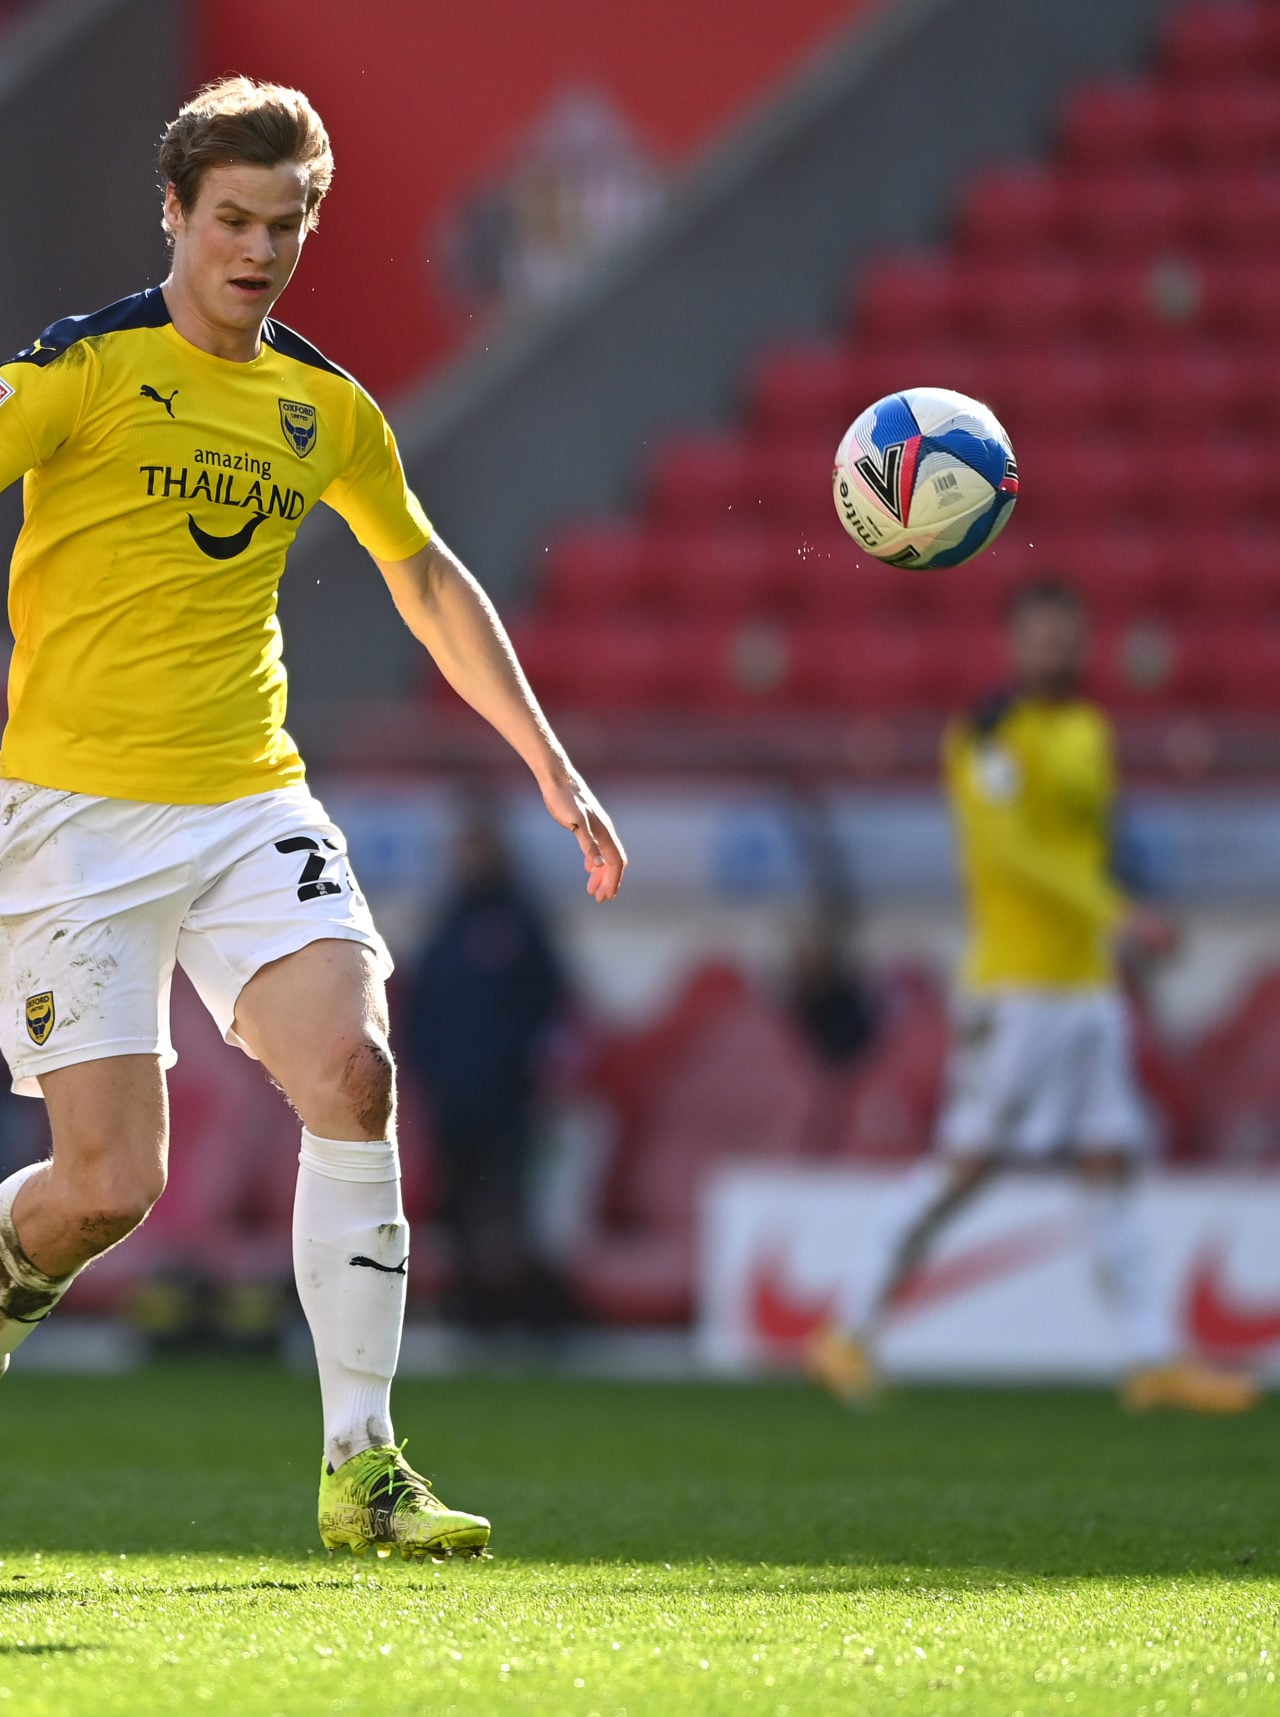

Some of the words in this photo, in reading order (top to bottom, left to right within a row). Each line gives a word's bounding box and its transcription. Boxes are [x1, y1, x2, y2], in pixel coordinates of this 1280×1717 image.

[283, 403, 313, 417] OXFORD
[139, 465, 305, 521] THAILAND
[193, 449, 272, 481] amazing
[840, 477, 878, 547] mitre
[274, 836, 355, 902] 2
